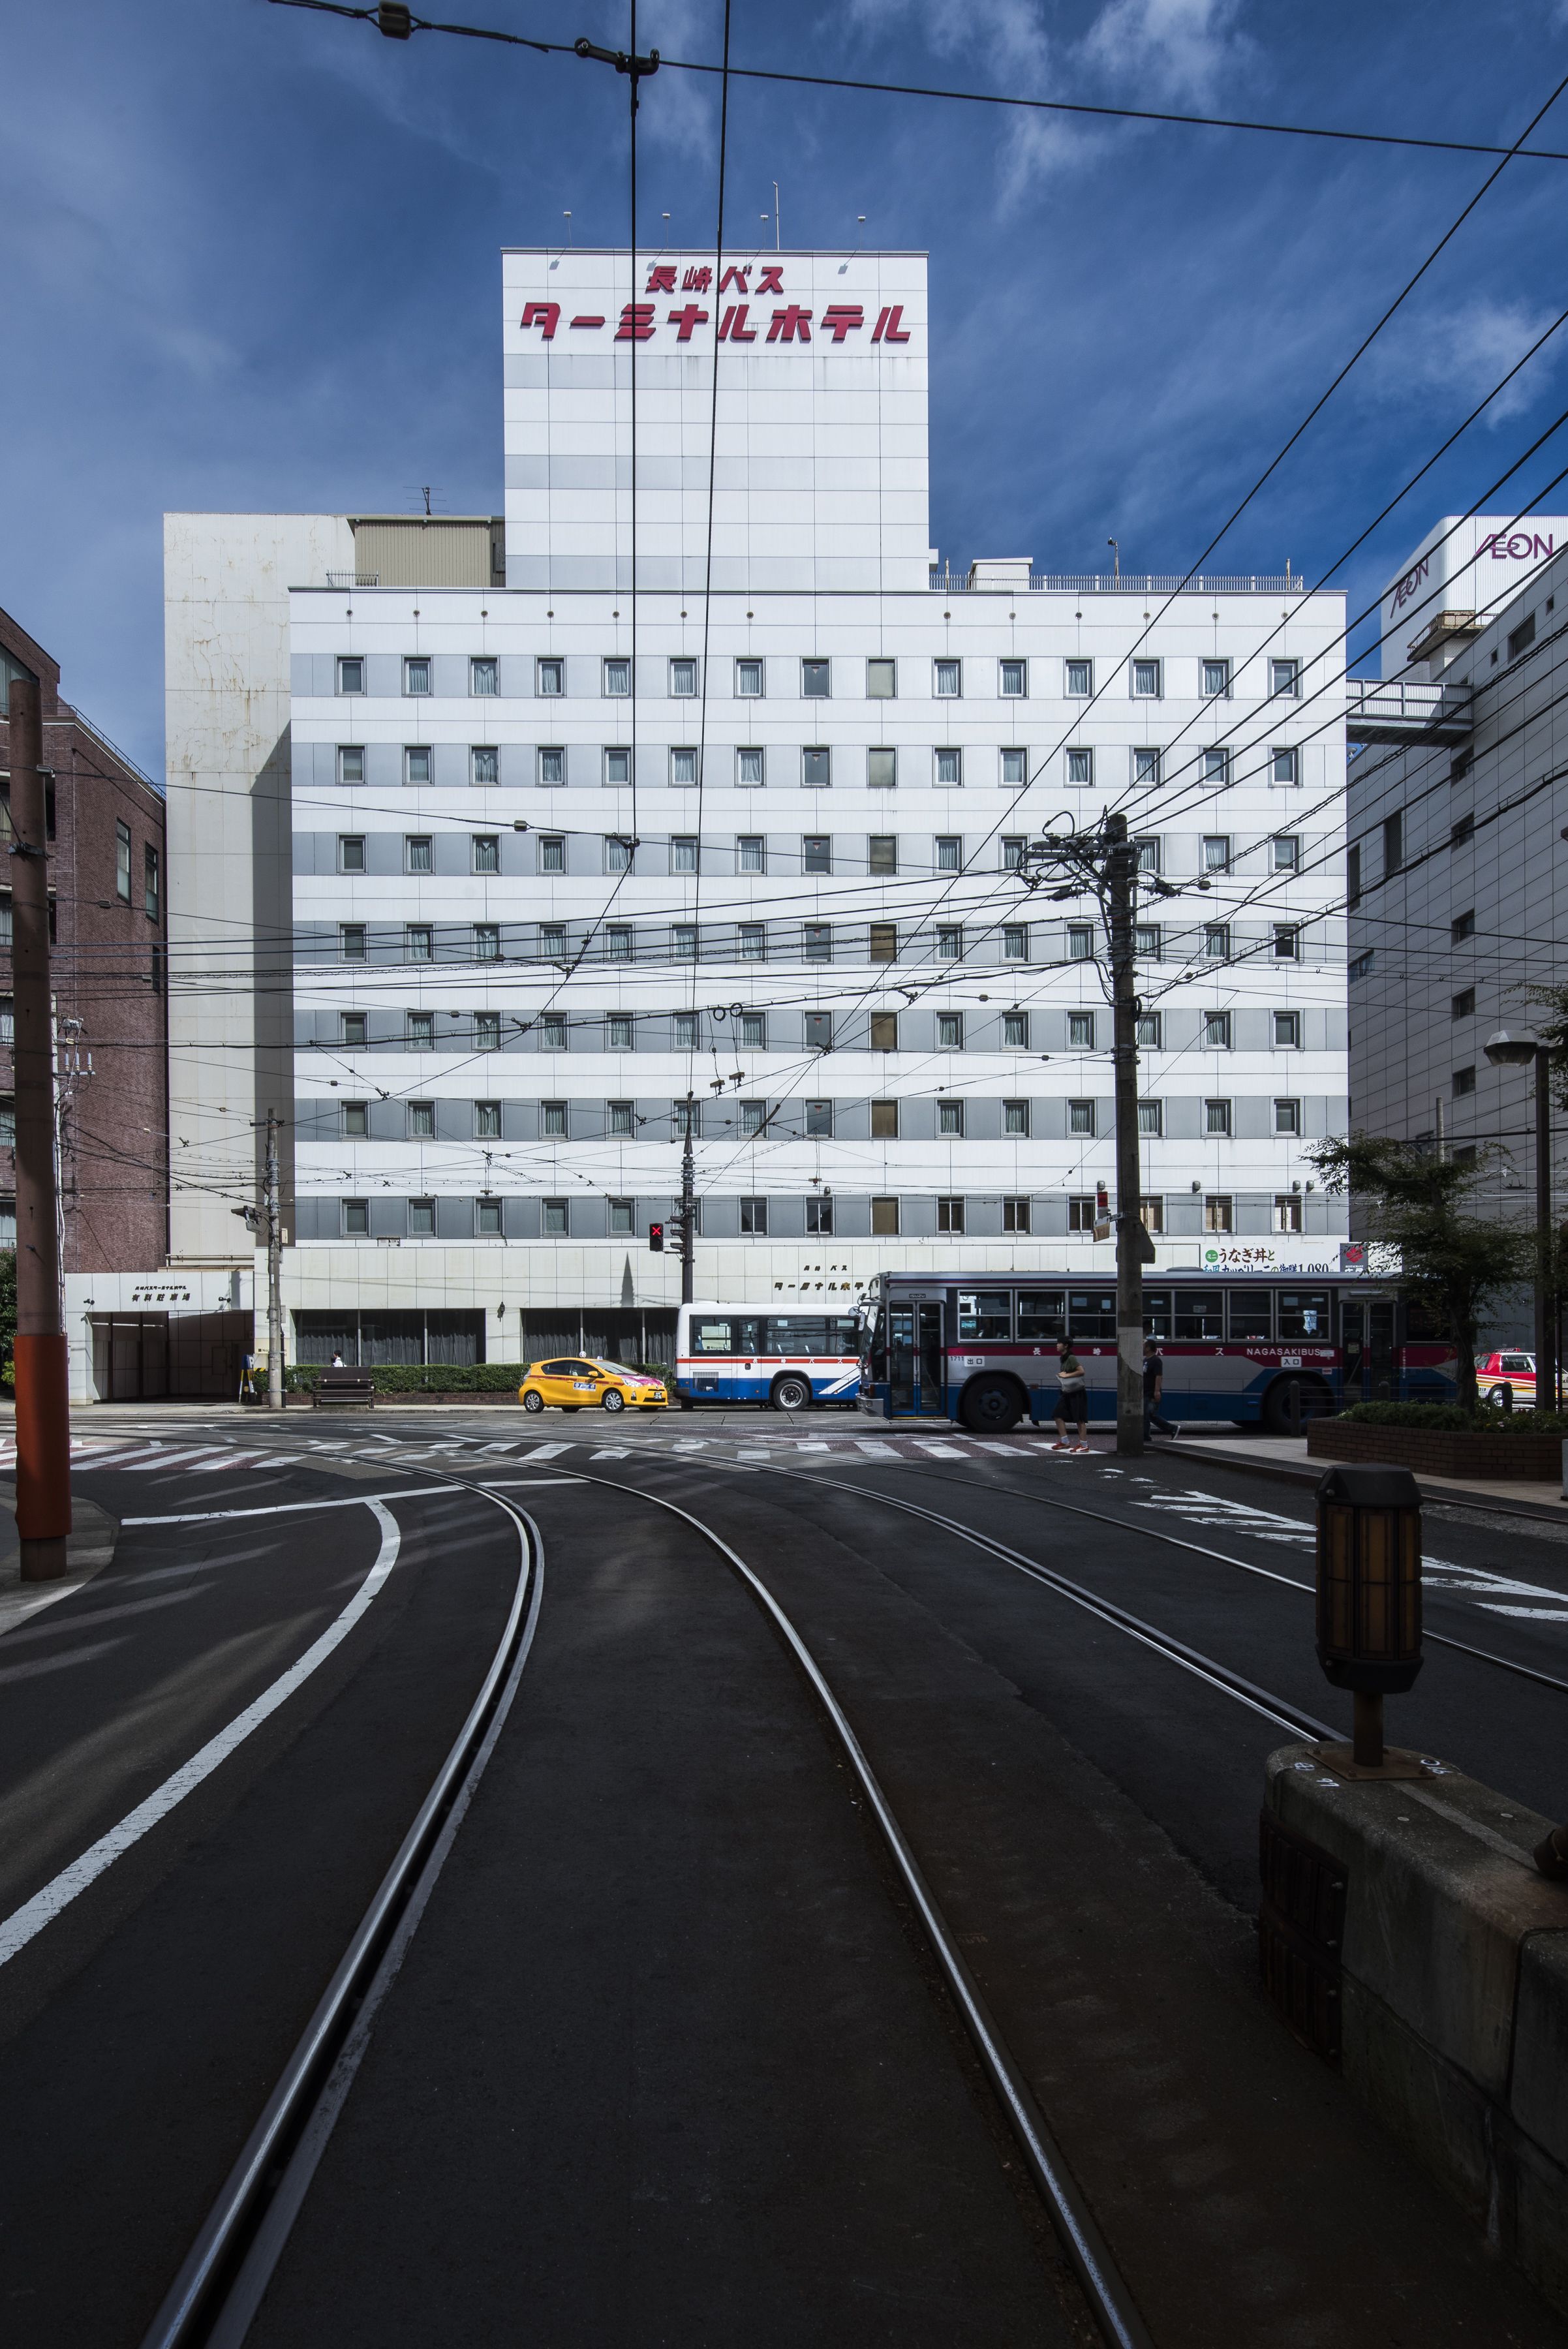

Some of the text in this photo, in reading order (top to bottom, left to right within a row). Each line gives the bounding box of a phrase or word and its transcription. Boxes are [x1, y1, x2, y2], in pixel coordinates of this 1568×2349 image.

[646, 266, 784, 293] 長崎バス
[519, 302, 912, 343] ターミナルホテル
